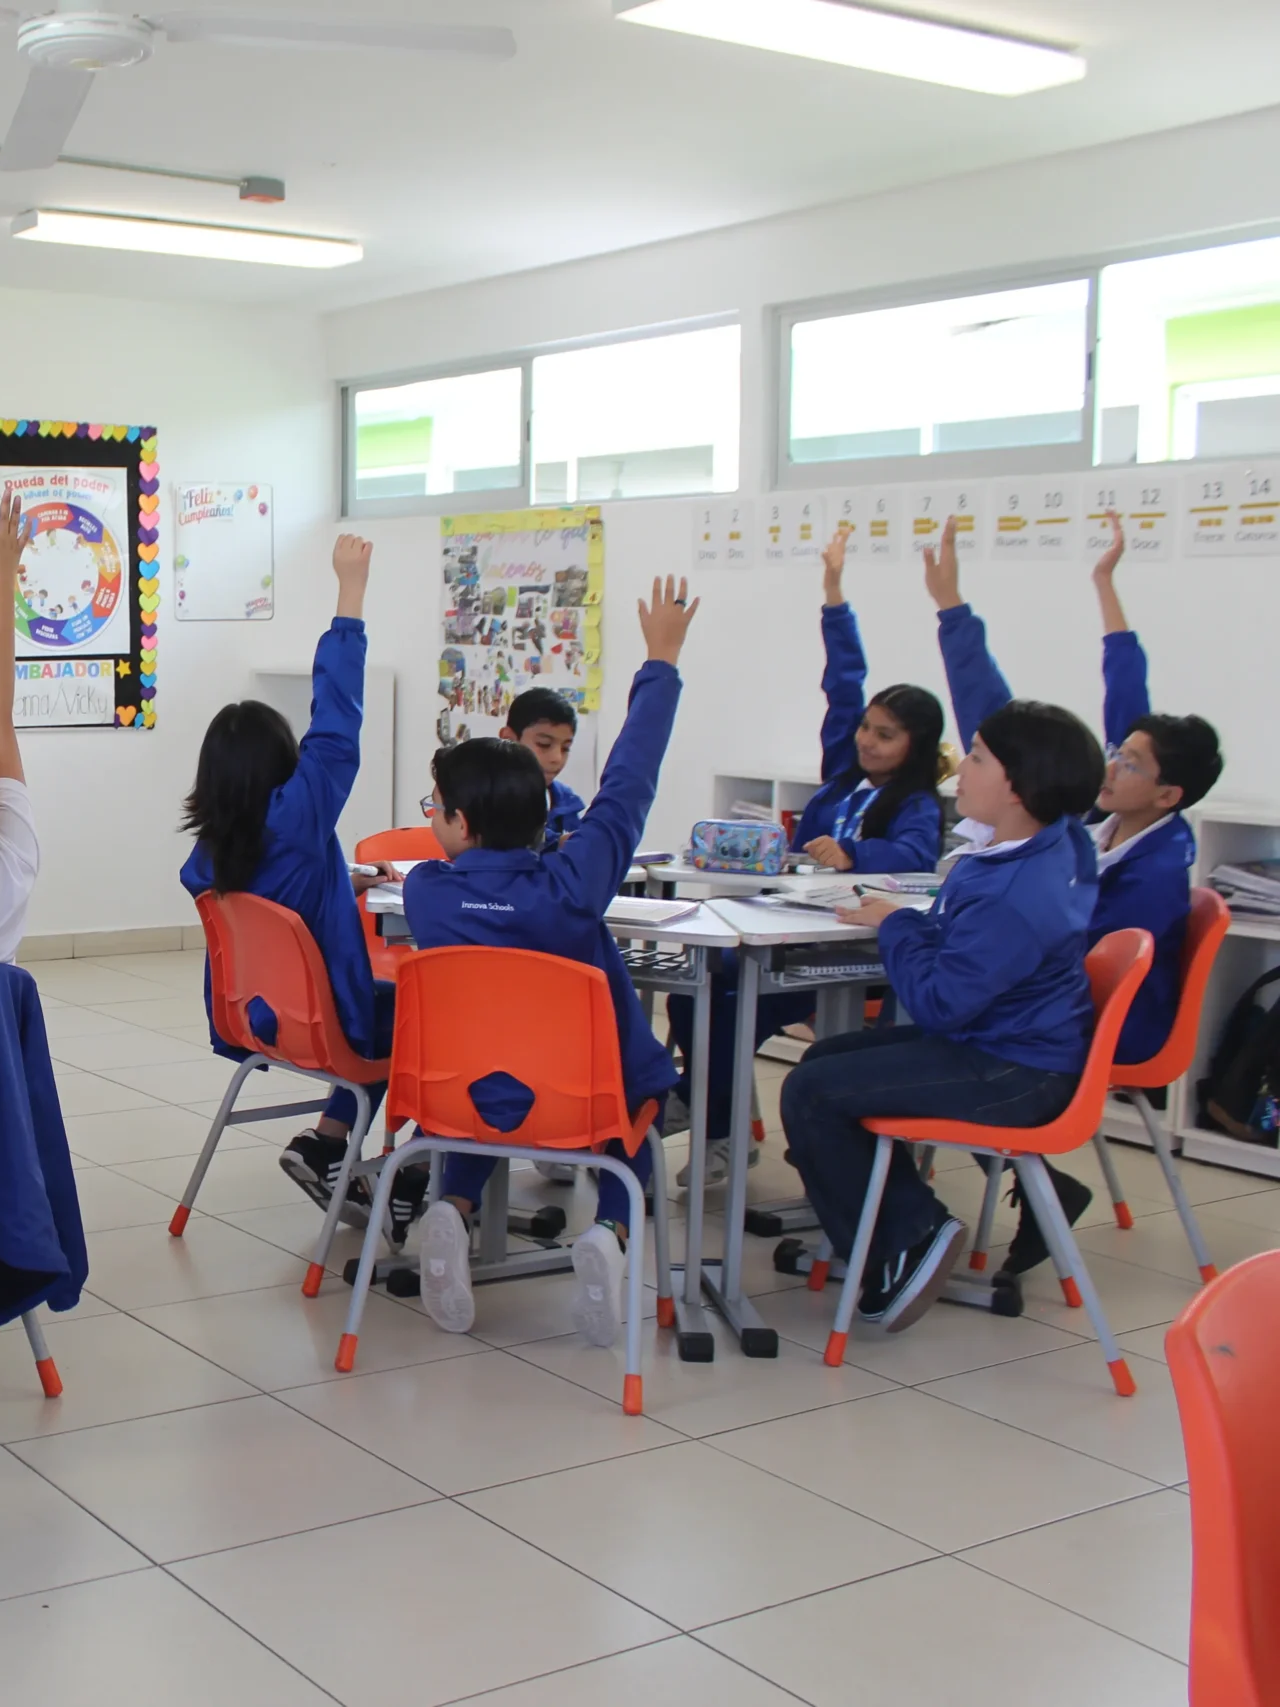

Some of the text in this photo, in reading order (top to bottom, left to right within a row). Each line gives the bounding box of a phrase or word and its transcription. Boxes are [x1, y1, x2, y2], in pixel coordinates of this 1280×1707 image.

[4, 474, 109, 494] Rueda del poder
[1202, 481, 1224, 499] 13
[1249, 478, 1272, 496] 14
[53, 488, 62, 497] of
[1097, 490, 1116, 507] 11
[1141, 488, 1161, 505] 12
[842, 500, 852, 515] 5
[876, 498, 885, 514] 6
[922, 496, 932, 511] 7
[957, 494, 967, 509] 8
[1008, 495, 1019, 511] 9
[1044, 492, 1063, 509] 10
[704, 510, 711, 524] 1
[731, 508, 740, 523] 2
[771, 506, 780, 520] 3
[802, 503, 811, 518] 4
[15, 662, 112, 680] MBAJADOR
[461, 900, 514, 911] Innova Schools
